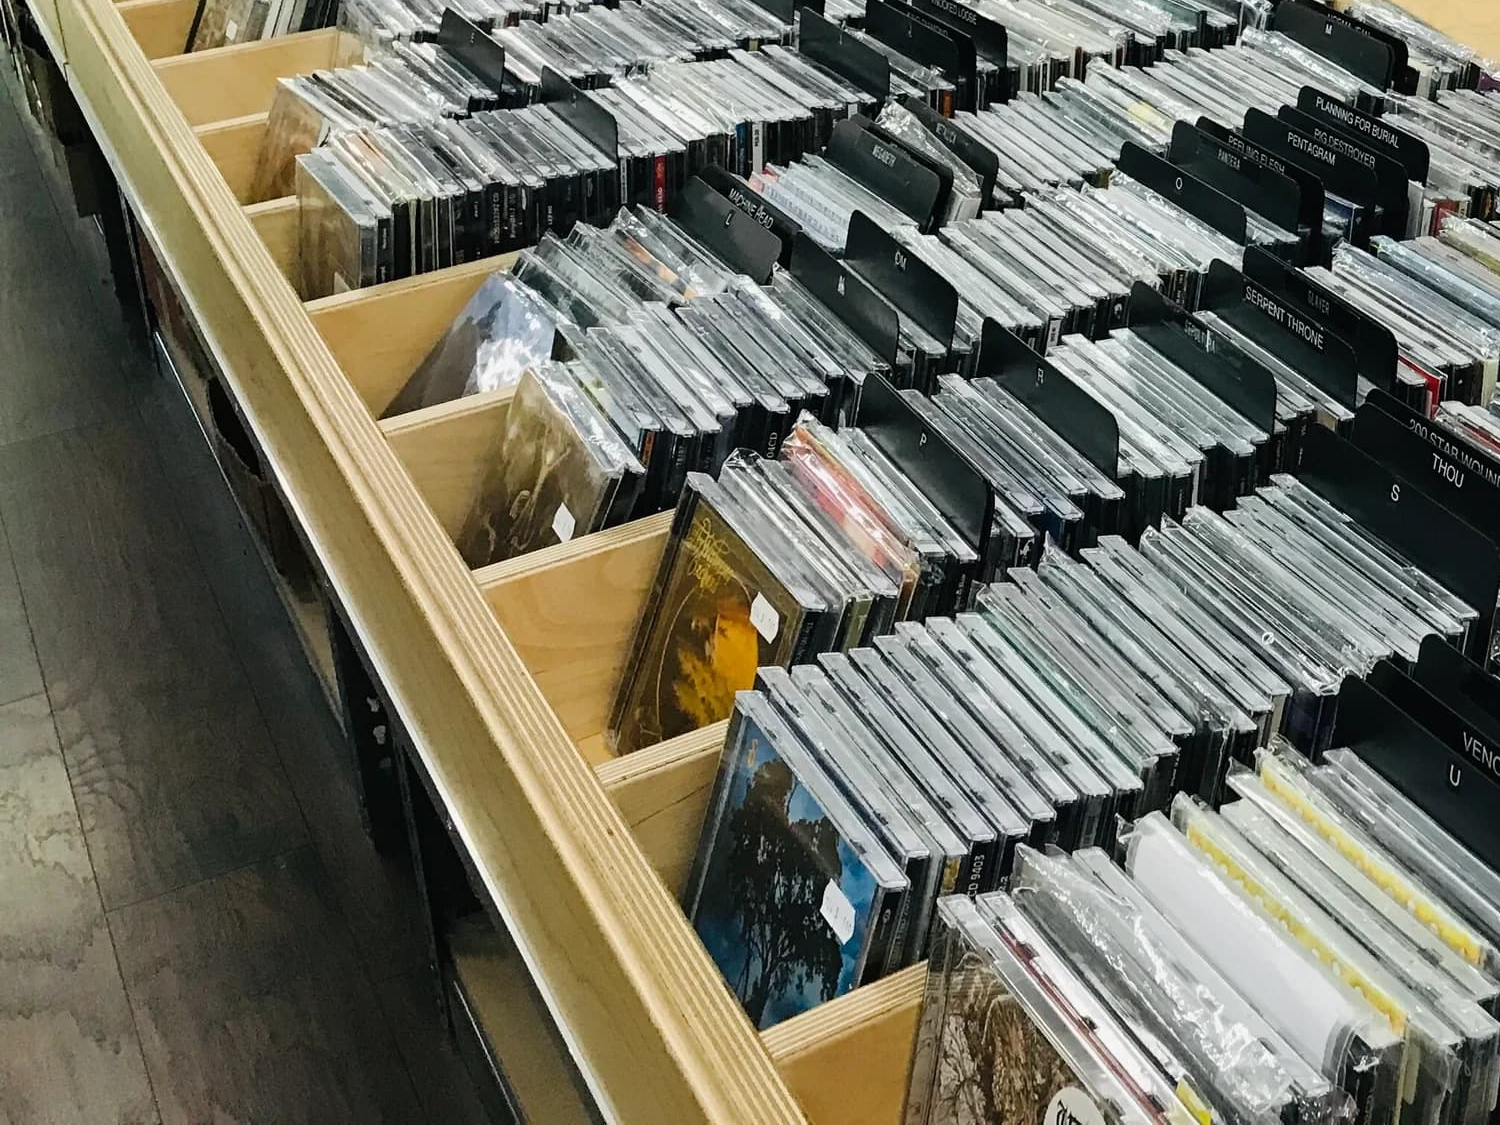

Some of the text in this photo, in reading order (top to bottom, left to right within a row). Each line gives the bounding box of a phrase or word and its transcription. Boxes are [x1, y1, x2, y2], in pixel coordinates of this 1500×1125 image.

[958, 10, 978, 25] LOOSE
[1316, 96, 1400, 149] PLANNING FOR BURIAL
[1287, 132, 1336, 166] PENTAGRAM
[1314, 127, 1376, 168] PIG DESTROYER
[728, 187, 756, 219] MACHINE
[1307, 290, 1330, 316] SLAYER
[1245, 286, 1325, 350] SERPENT THRONE
[919, 432, 928, 448] P
[1410, 418, 1428, 443] 200
[1432, 453, 1465, 489] THOU
[1390, 484, 1401, 502] S
[1449, 765, 1461, 787] U
[971, 854, 985, 883] 9403
